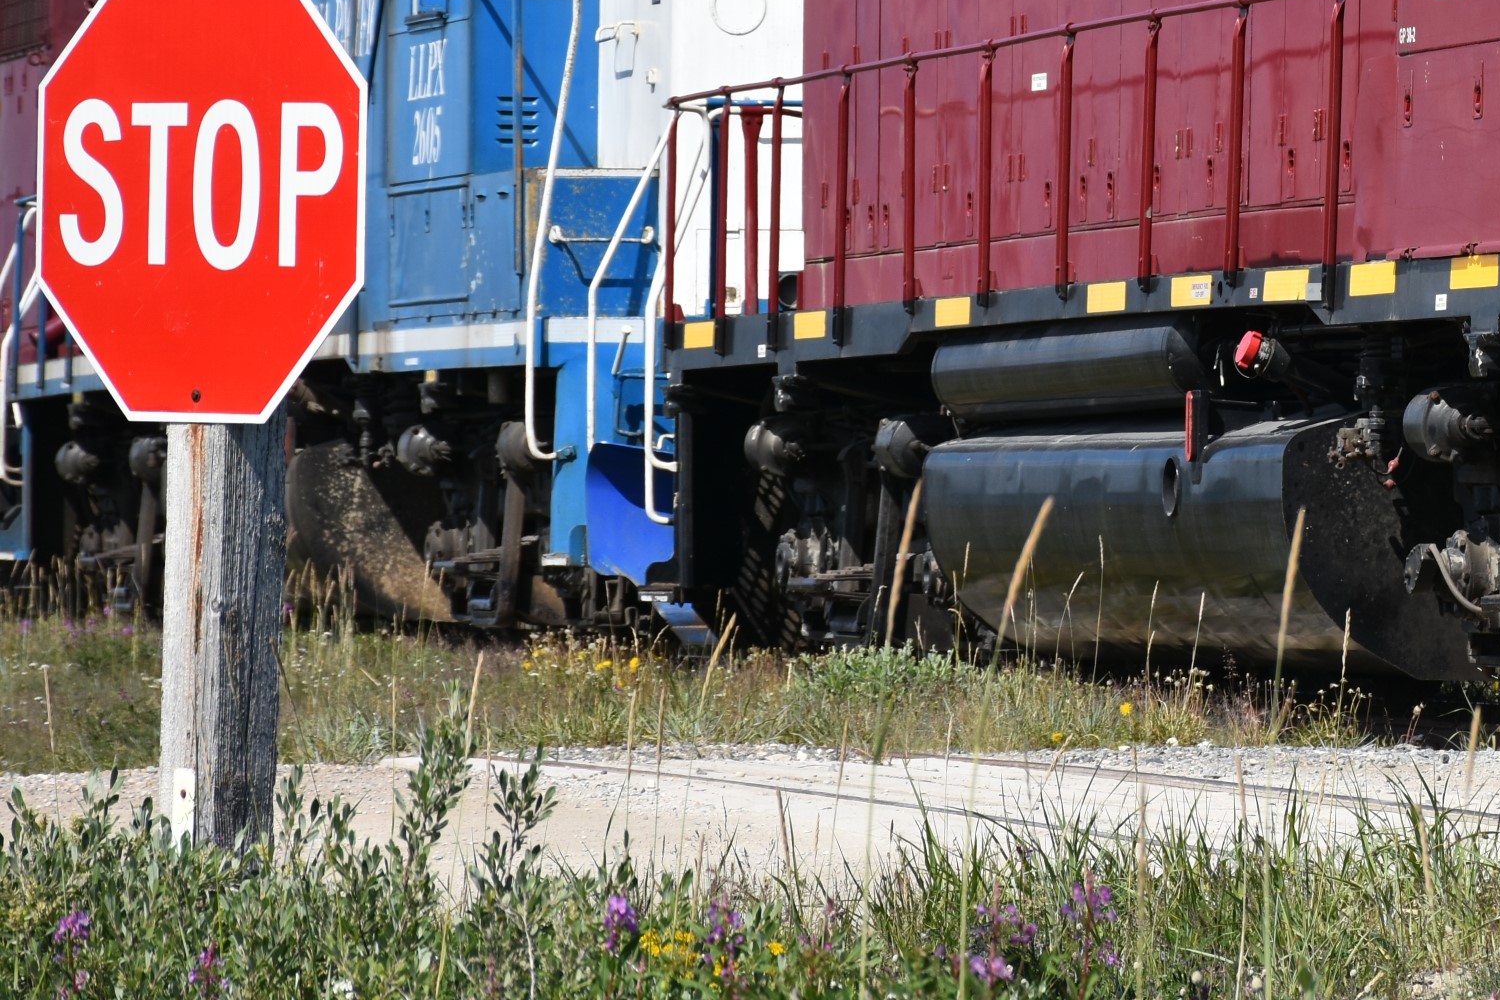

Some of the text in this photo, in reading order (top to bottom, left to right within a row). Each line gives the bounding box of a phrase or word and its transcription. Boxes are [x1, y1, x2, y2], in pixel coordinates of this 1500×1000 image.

[407, 38, 448, 102] LLPX
[411, 105, 443, 166] 2605
[60, 98, 344, 271] STOP
